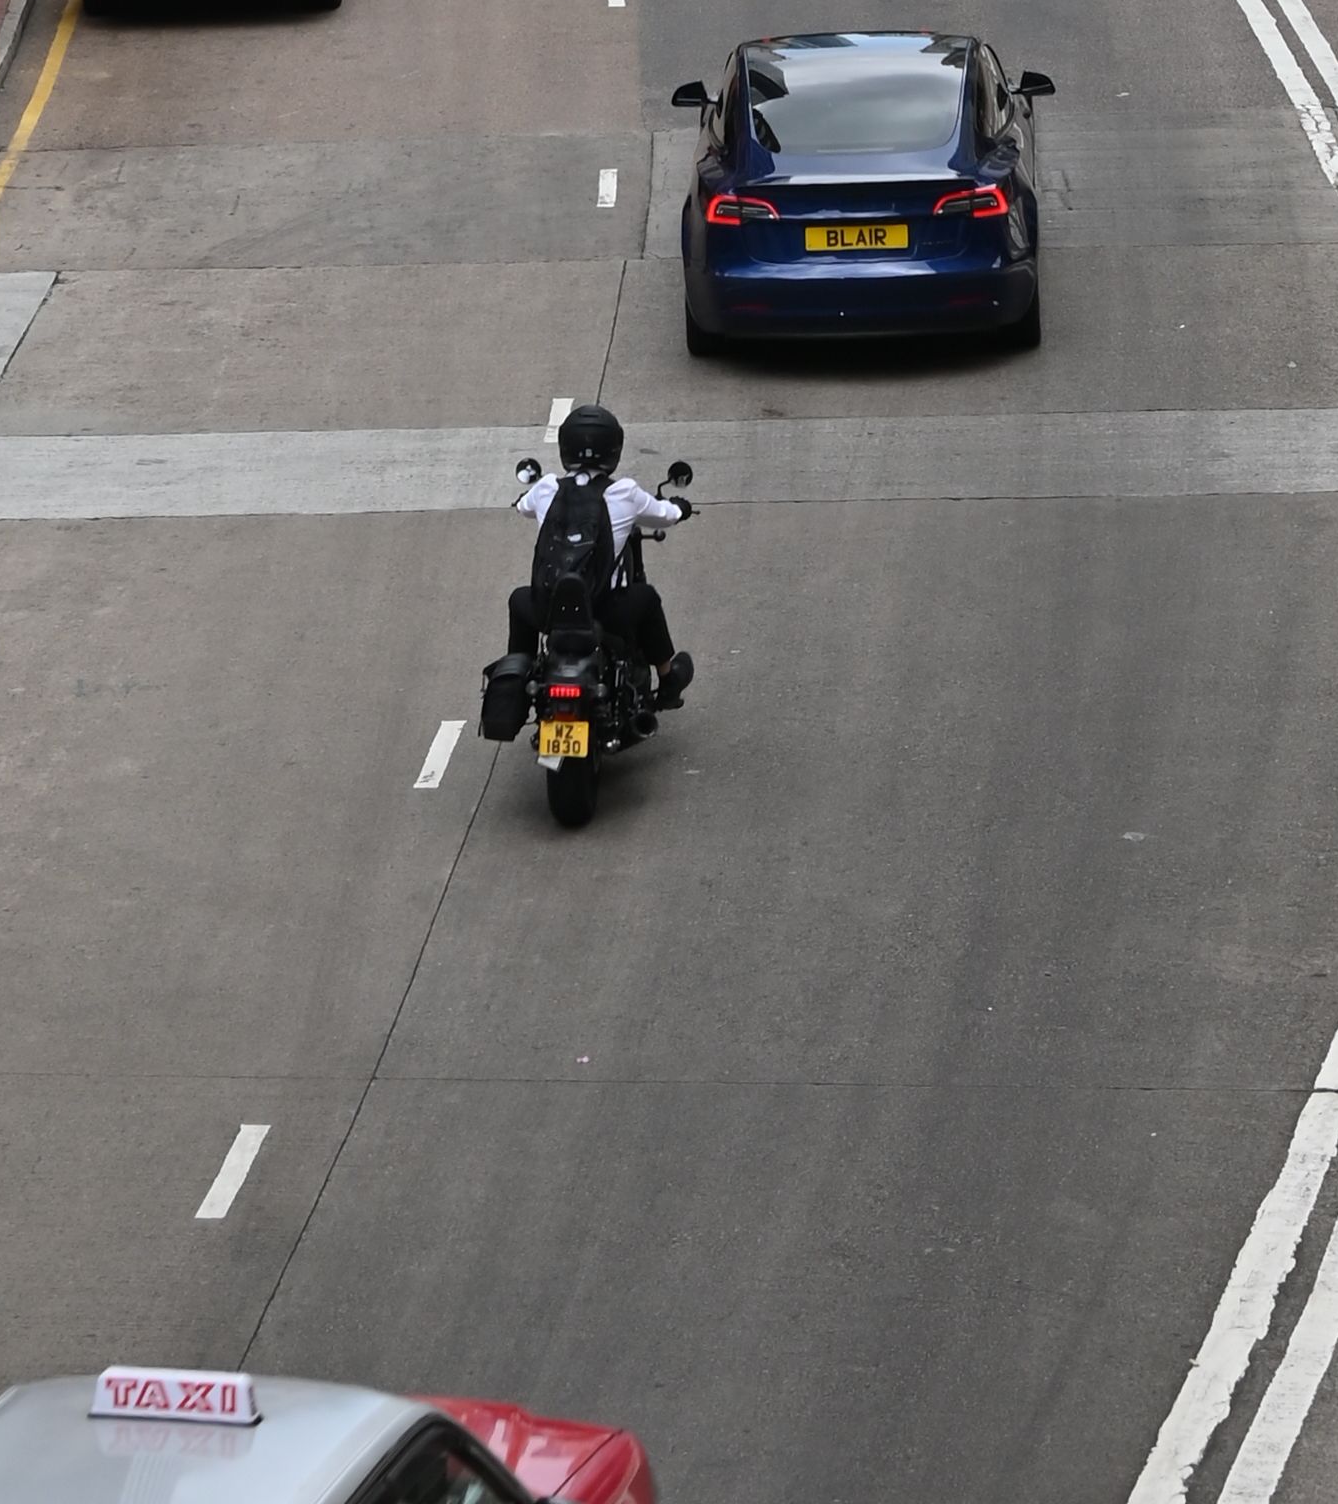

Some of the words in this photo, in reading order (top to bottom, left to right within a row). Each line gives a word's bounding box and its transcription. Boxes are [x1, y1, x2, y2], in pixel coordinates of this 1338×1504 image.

[826, 228, 887, 247] BLAIR
[553, 723, 574, 739] WZ
[546, 738, 583, 756] 1830
[104, 1376, 239, 1415] TAXI
